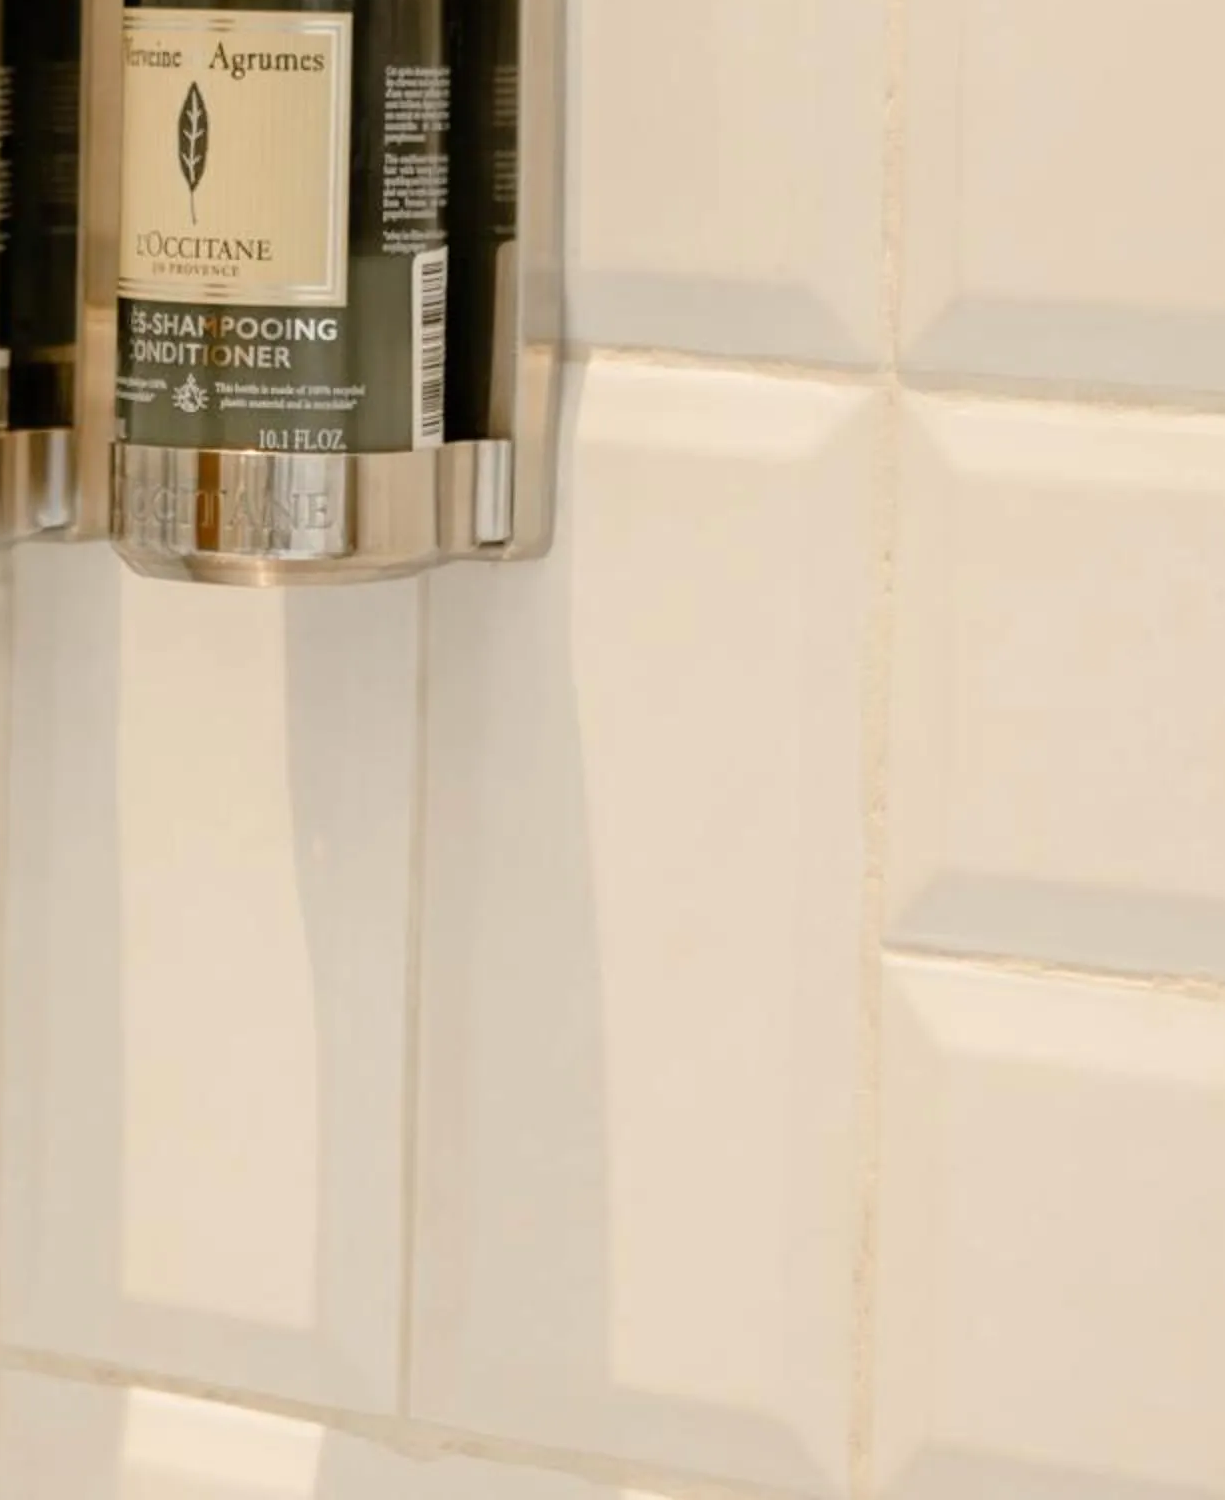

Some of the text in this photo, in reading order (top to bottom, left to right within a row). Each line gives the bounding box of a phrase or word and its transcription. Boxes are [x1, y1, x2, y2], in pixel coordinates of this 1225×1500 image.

[208, 41, 325, 80] Agrumes
[136, 230, 273, 261] L'OCCITANE
[259, 429, 289, 450] 10.1
